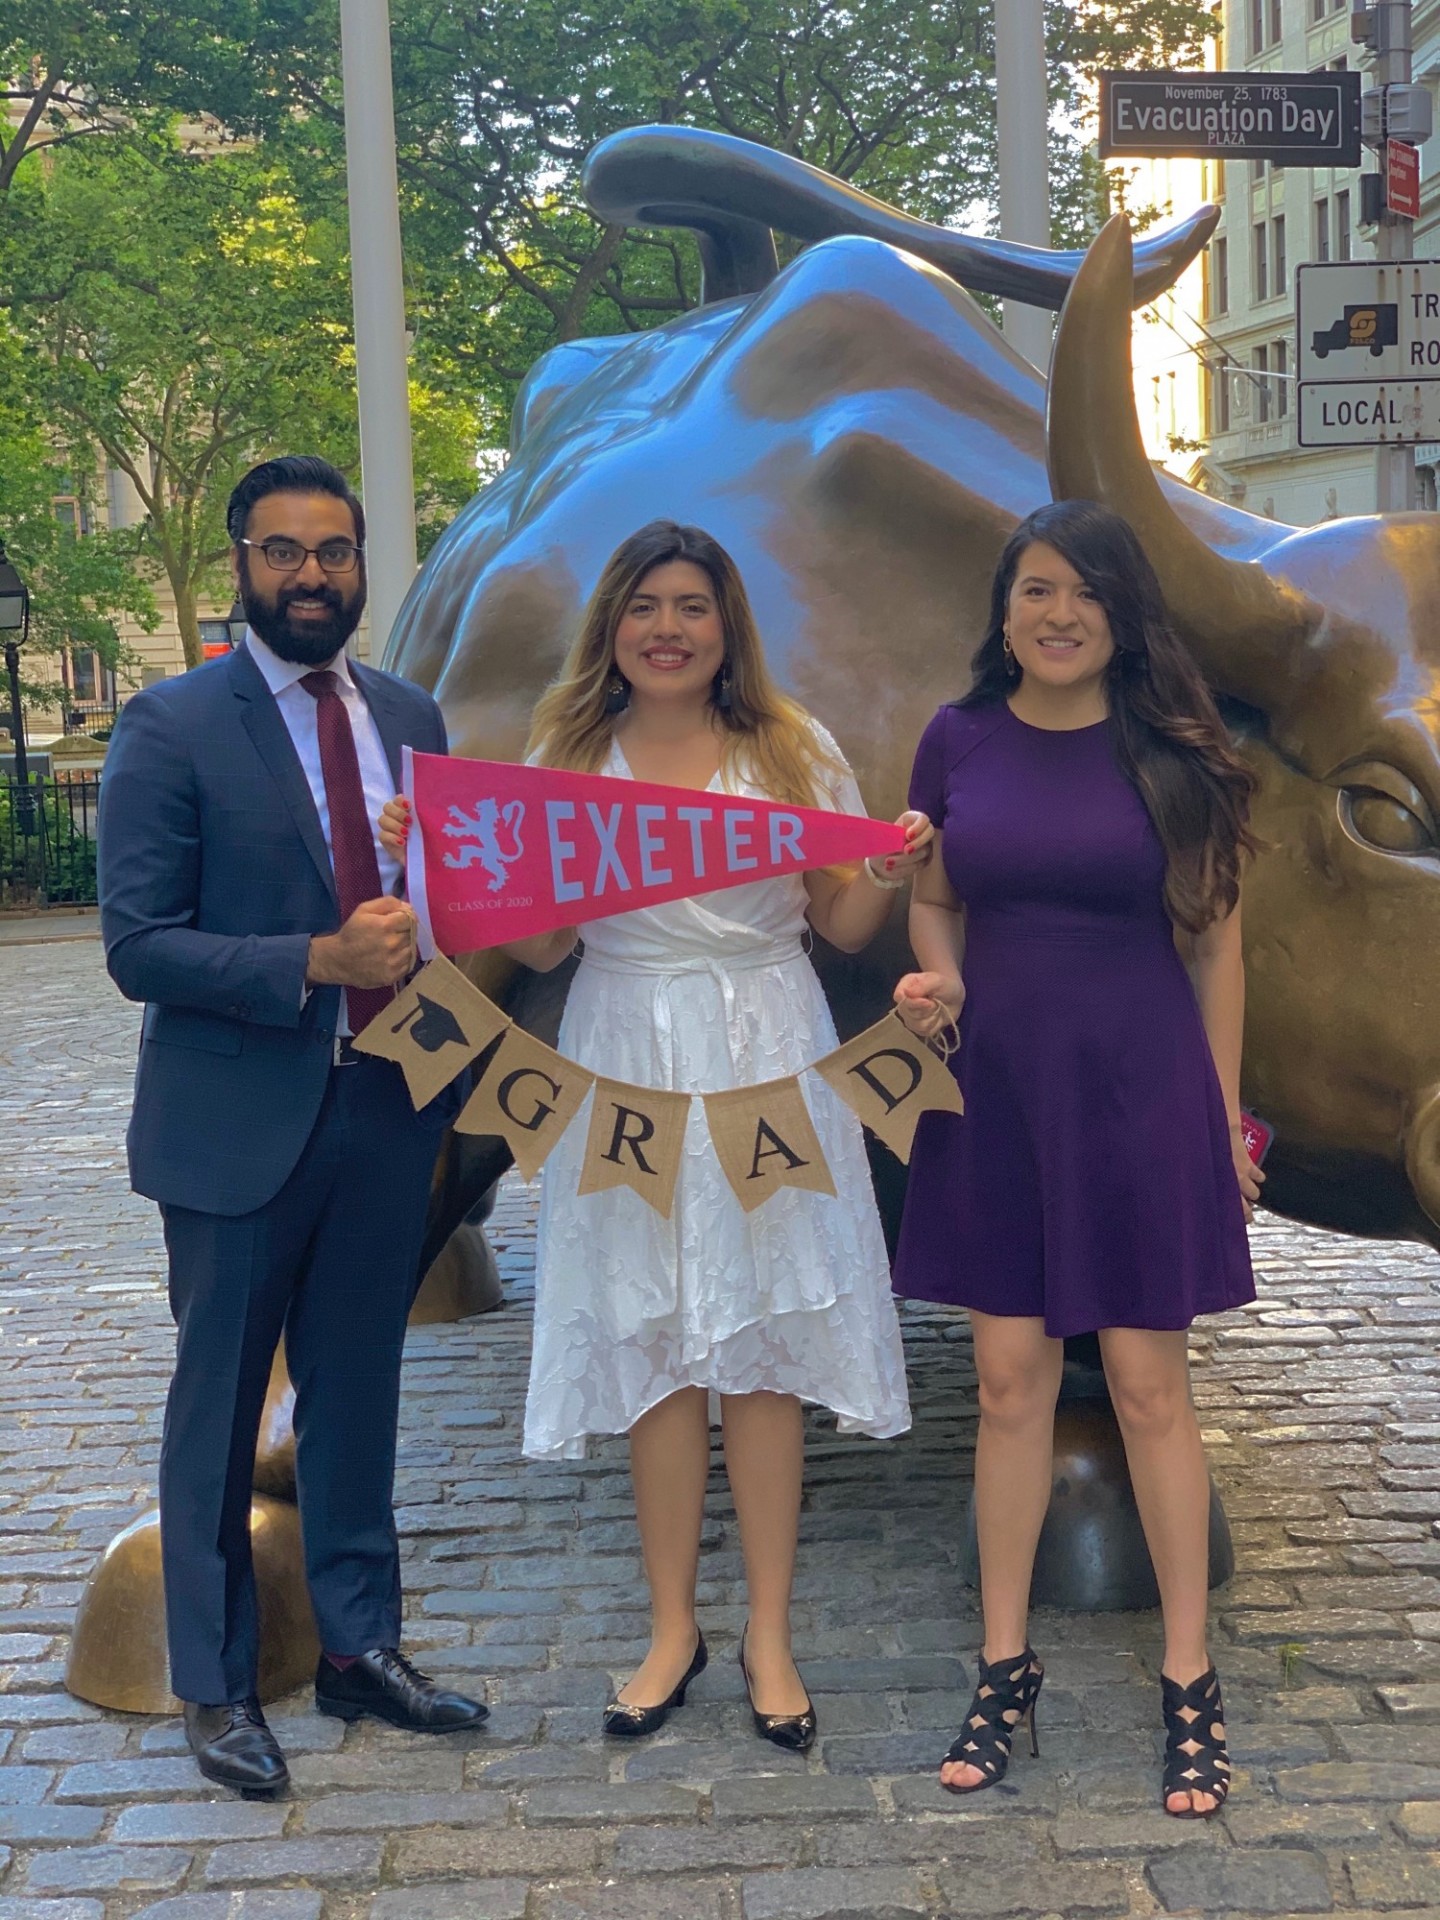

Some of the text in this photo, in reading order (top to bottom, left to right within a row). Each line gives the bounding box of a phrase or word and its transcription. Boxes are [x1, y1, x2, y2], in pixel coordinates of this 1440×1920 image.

[1165, 86, 1288, 101] November 25, 1783
[1117, 98, 1334, 140] Evacuation Day
[1208, 132, 1246, 145] PLAZA
[1323, 400, 1402, 426] LOCAL
[545, 800, 806, 904] EXETER
[448, 896, 533, 912] CLASS OF 2020
